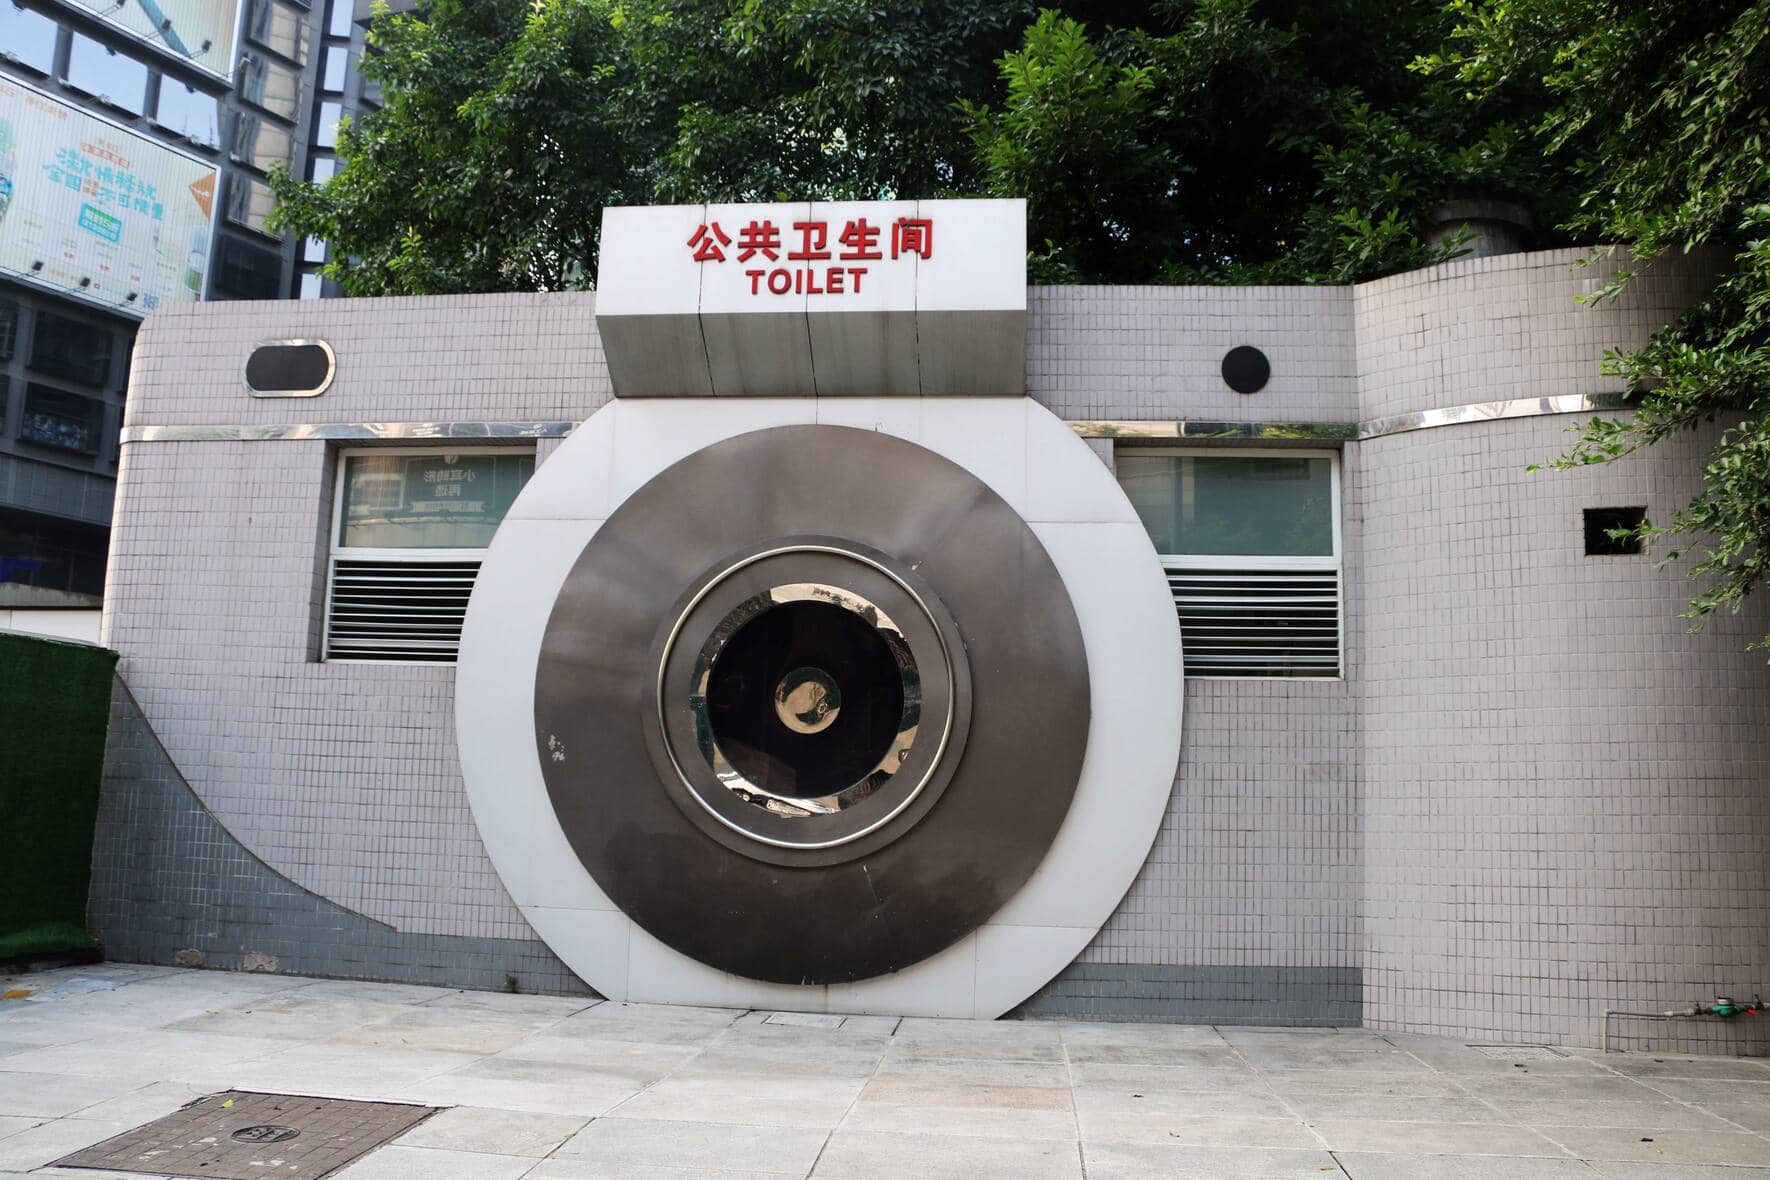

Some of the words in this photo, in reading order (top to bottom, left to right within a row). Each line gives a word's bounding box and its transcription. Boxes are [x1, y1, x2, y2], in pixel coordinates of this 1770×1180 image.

[687, 217, 934, 264] 公共卫生间
[745, 267, 868, 295] TOILET
